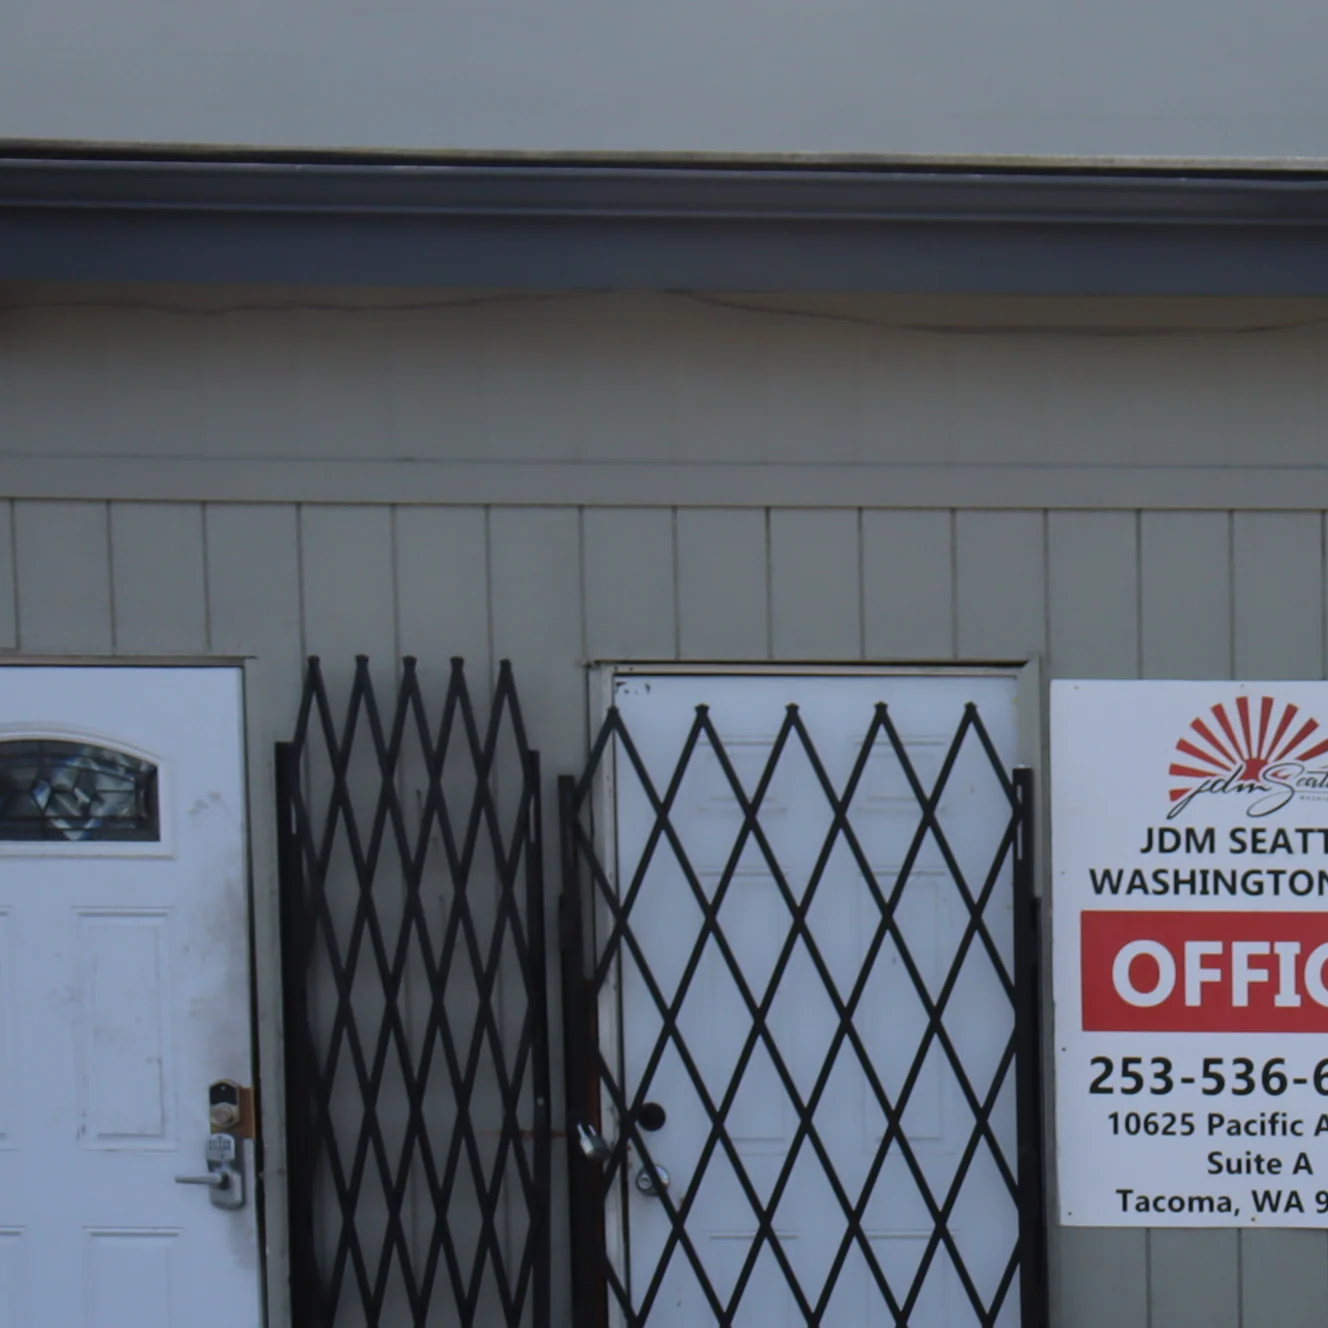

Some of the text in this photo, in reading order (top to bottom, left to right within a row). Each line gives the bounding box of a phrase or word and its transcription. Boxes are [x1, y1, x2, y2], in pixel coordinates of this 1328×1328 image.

[1140, 827, 1216, 855] JDM
[1108, 1111, 1195, 1137] 10625
[1207, 1111, 1304, 1137] Pacific
[1207, 1150, 1314, 1176] Suite A
[1115, 1189, 1240, 1217] Tacoma,
[1251, 1189, 1305, 1214] WA
